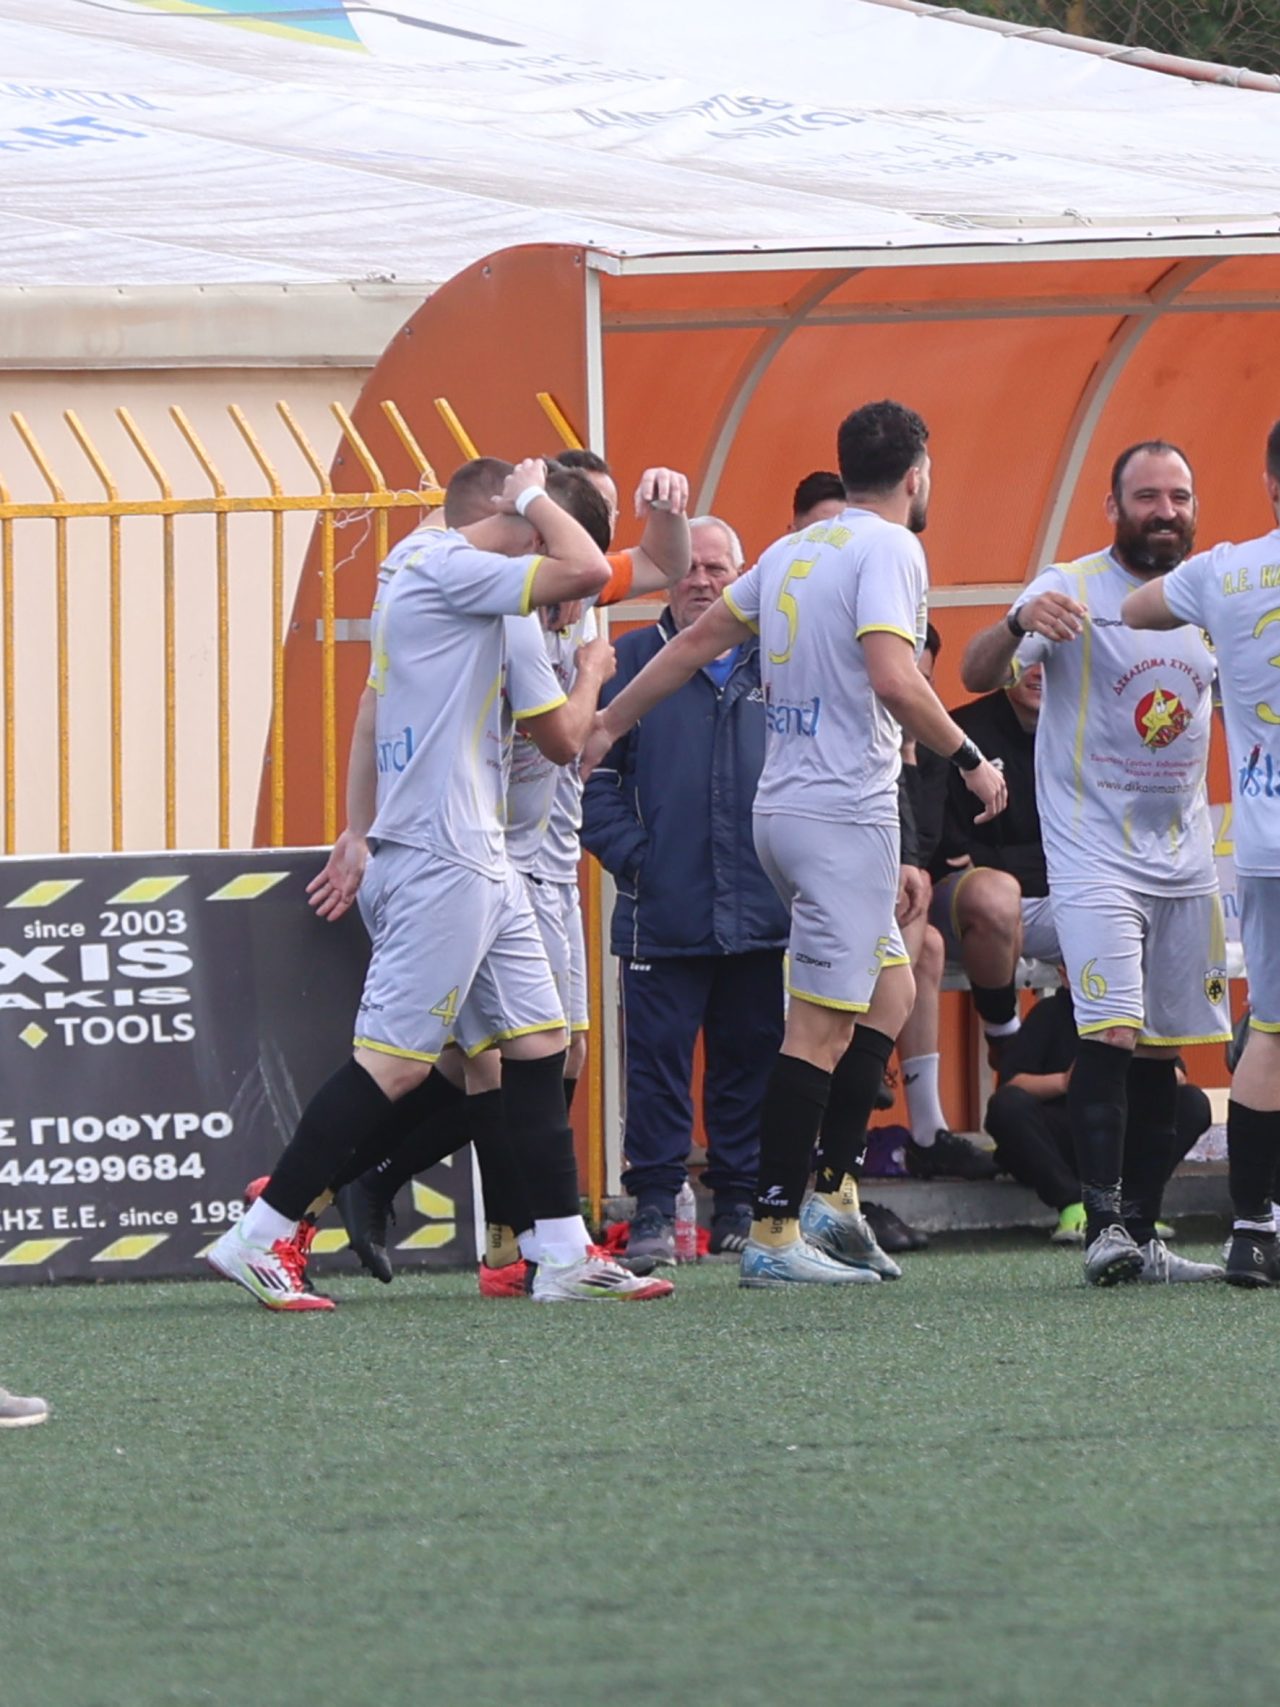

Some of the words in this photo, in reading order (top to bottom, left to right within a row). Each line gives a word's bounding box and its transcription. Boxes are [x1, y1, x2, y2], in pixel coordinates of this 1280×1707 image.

[767, 553, 821, 665] 5
[23, 920, 86, 939] since
[99, 909, 188, 937] 2003
[1080, 957, 1107, 1001] 6
[428, 985, 459, 1027] 4
[54, 1013, 196, 1046] TOOLS
[30, 1111, 234, 1145] ΓΙΟΦΥΡΟ
[0, 1152, 205, 1186] 44299684
[0, 1208, 45, 1232] ΗΣ
[118, 1207, 179, 1227] since
[189, 1200, 246, 1225] 198
